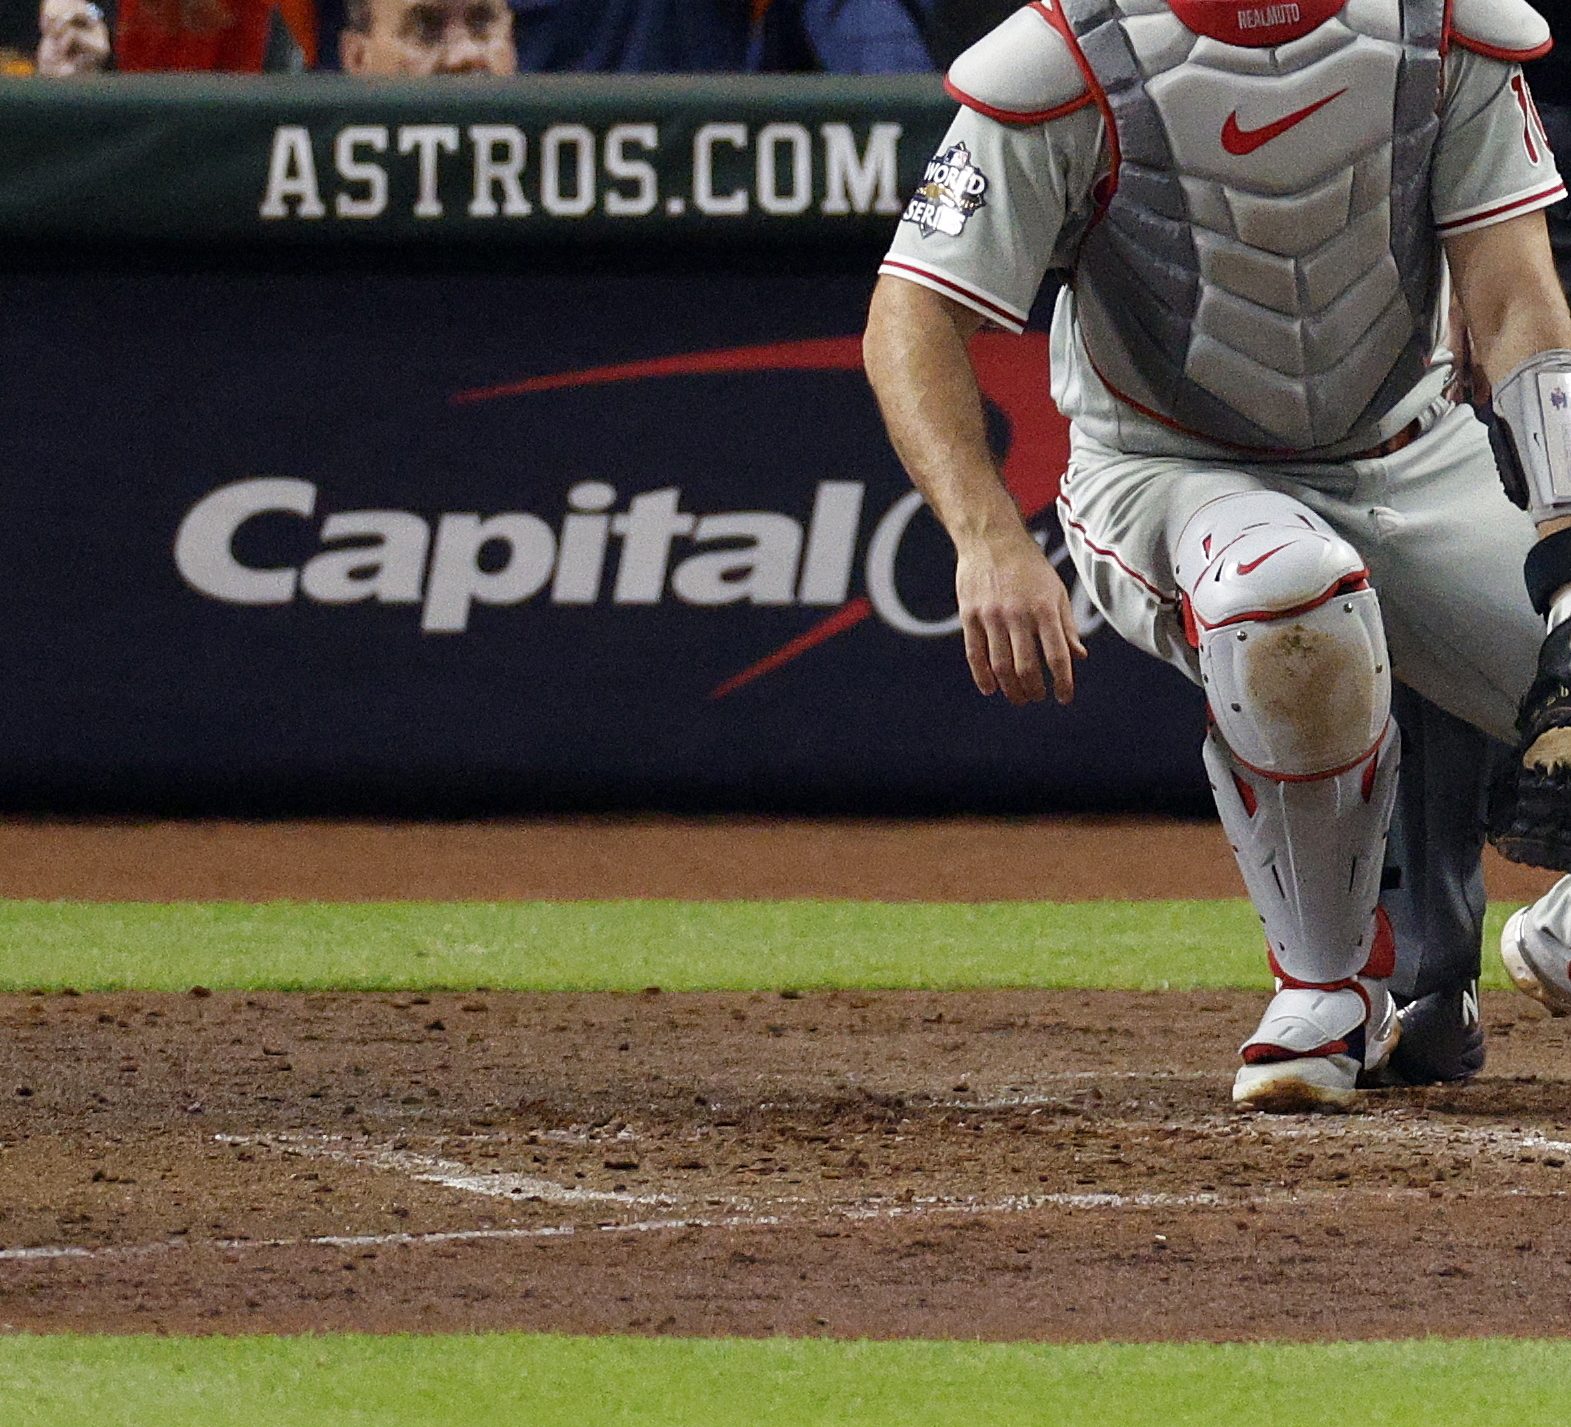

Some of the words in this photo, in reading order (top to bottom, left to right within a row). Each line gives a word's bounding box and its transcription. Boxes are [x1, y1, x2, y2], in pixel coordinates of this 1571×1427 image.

[1237, 3, 1300, 30] REALMUTO
[258, 123, 903, 219] ASTROS.COM
[902, 199, 966, 236] SERI
[174, 477, 1104, 637] CapitalO
